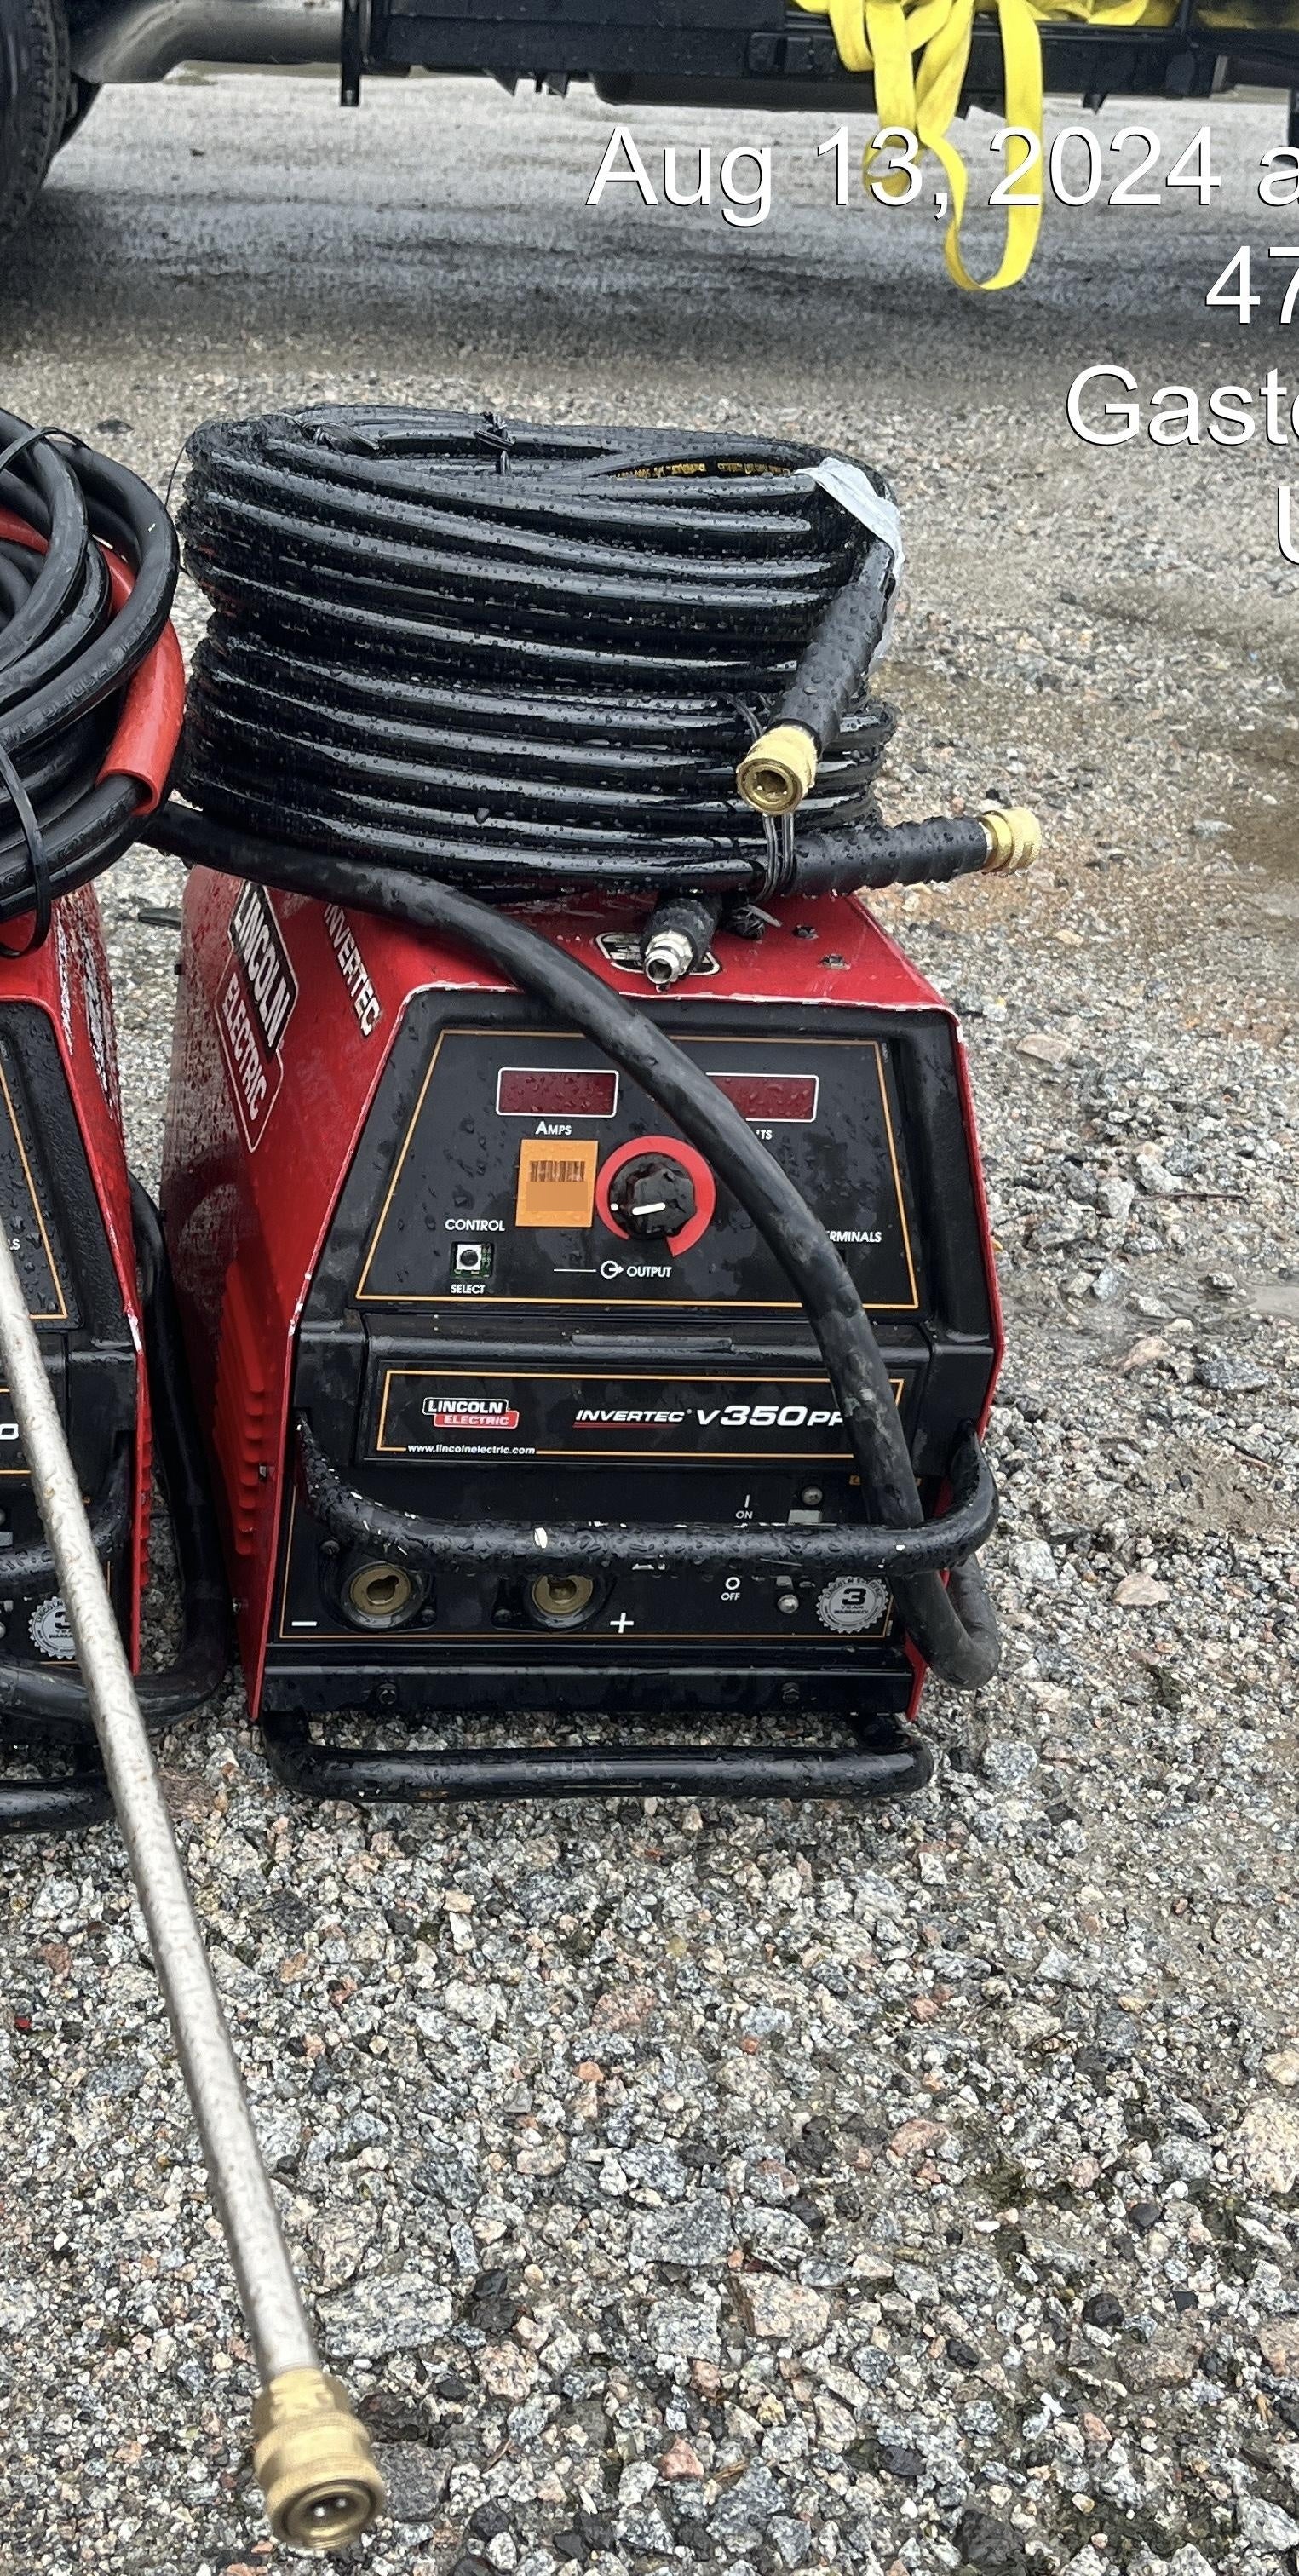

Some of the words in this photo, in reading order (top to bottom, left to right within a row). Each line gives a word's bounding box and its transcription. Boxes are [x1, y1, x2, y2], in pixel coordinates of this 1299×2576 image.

[233, 879, 290, 1048] LINCOLN
[323, 903, 381, 1037] INVERTEC
[221, 973, 267, 1121] ELECTRIC
[445, 1218, 505, 1232] CONTROL
[626, 1265, 672, 1278] OUTPUT
[451, 1284, 486, 1295] SELECT
[428, 1400, 503, 1414] LINCOLN
[444, 1414, 509, 1426] ELECTRIC
[407, 1443, 535, 1455] www.lincolnelectric.com
[735, 1510, 753, 1519] ON
[721, 1592, 740, 1601] OFF
[841, 1588, 867, 1606] 3
